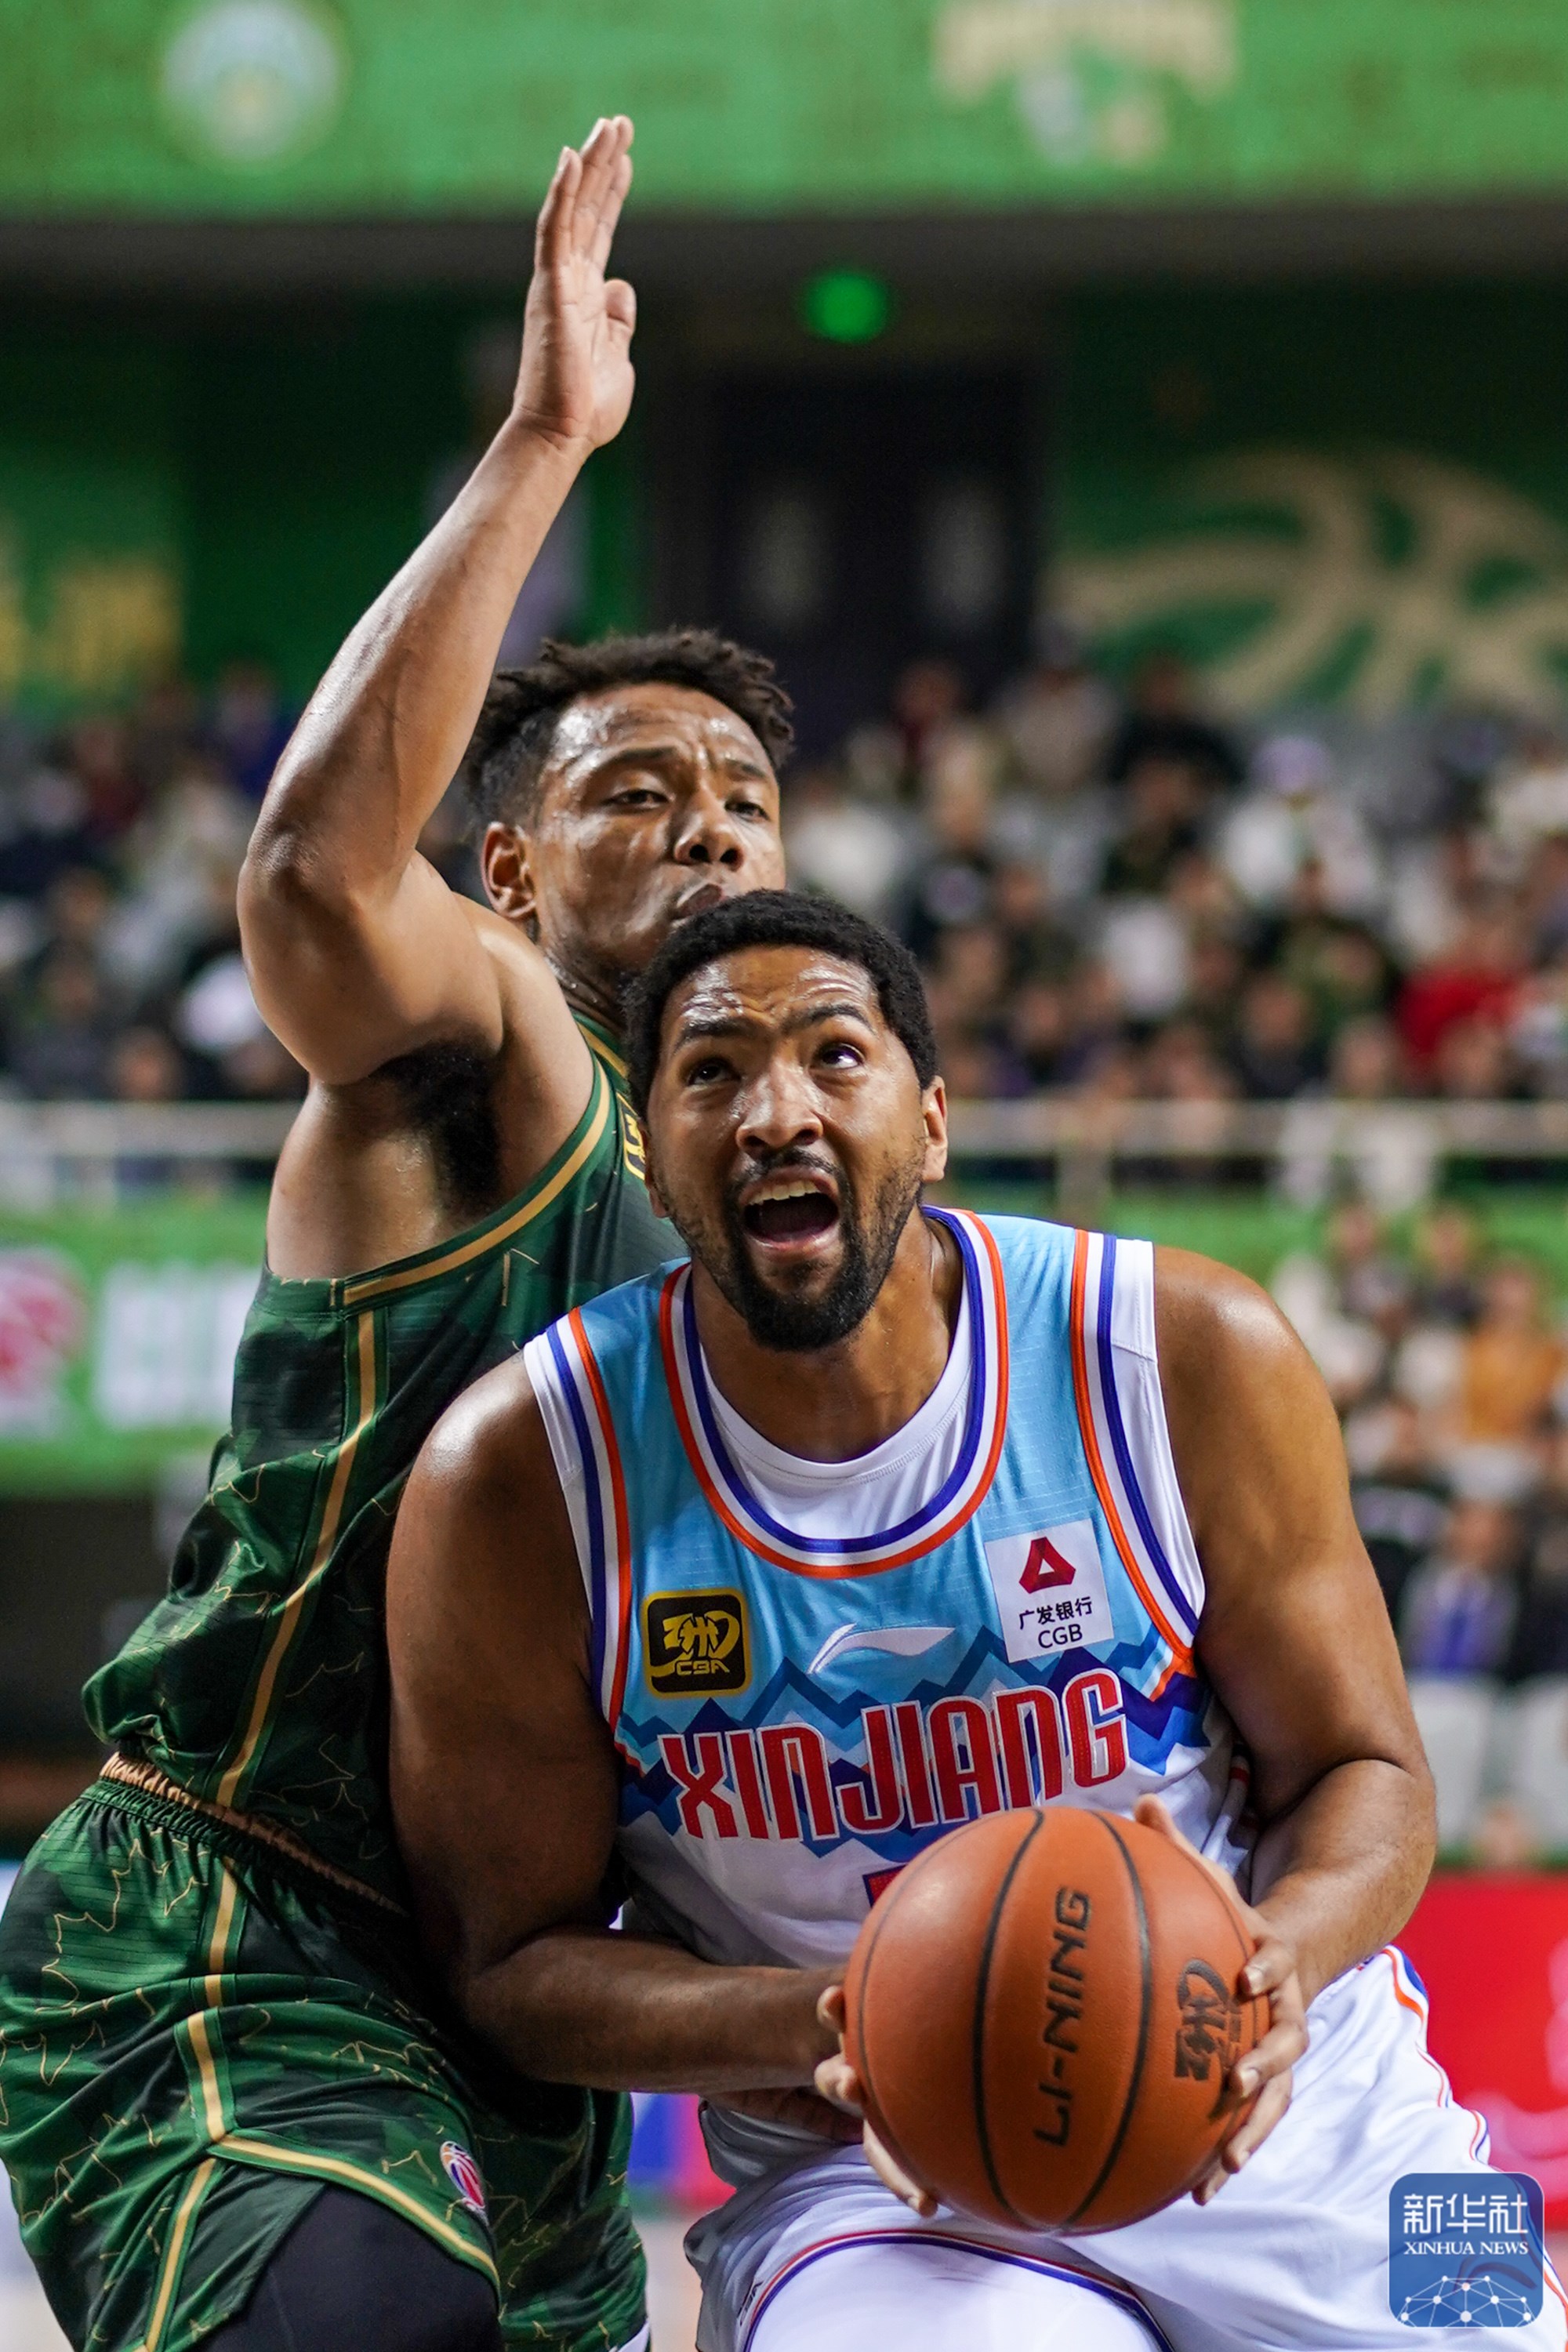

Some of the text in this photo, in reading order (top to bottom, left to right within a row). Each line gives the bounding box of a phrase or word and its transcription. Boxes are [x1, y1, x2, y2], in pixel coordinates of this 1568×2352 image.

[1018, 1595, 1093, 1631] 广发银行
[1037, 1623, 1083, 1649] CGB
[675, 1658, 731, 1676] CBA
[657, 1668, 1131, 1841] XINJIANG
[1033, 1885, 1092, 2147] LI-NING
